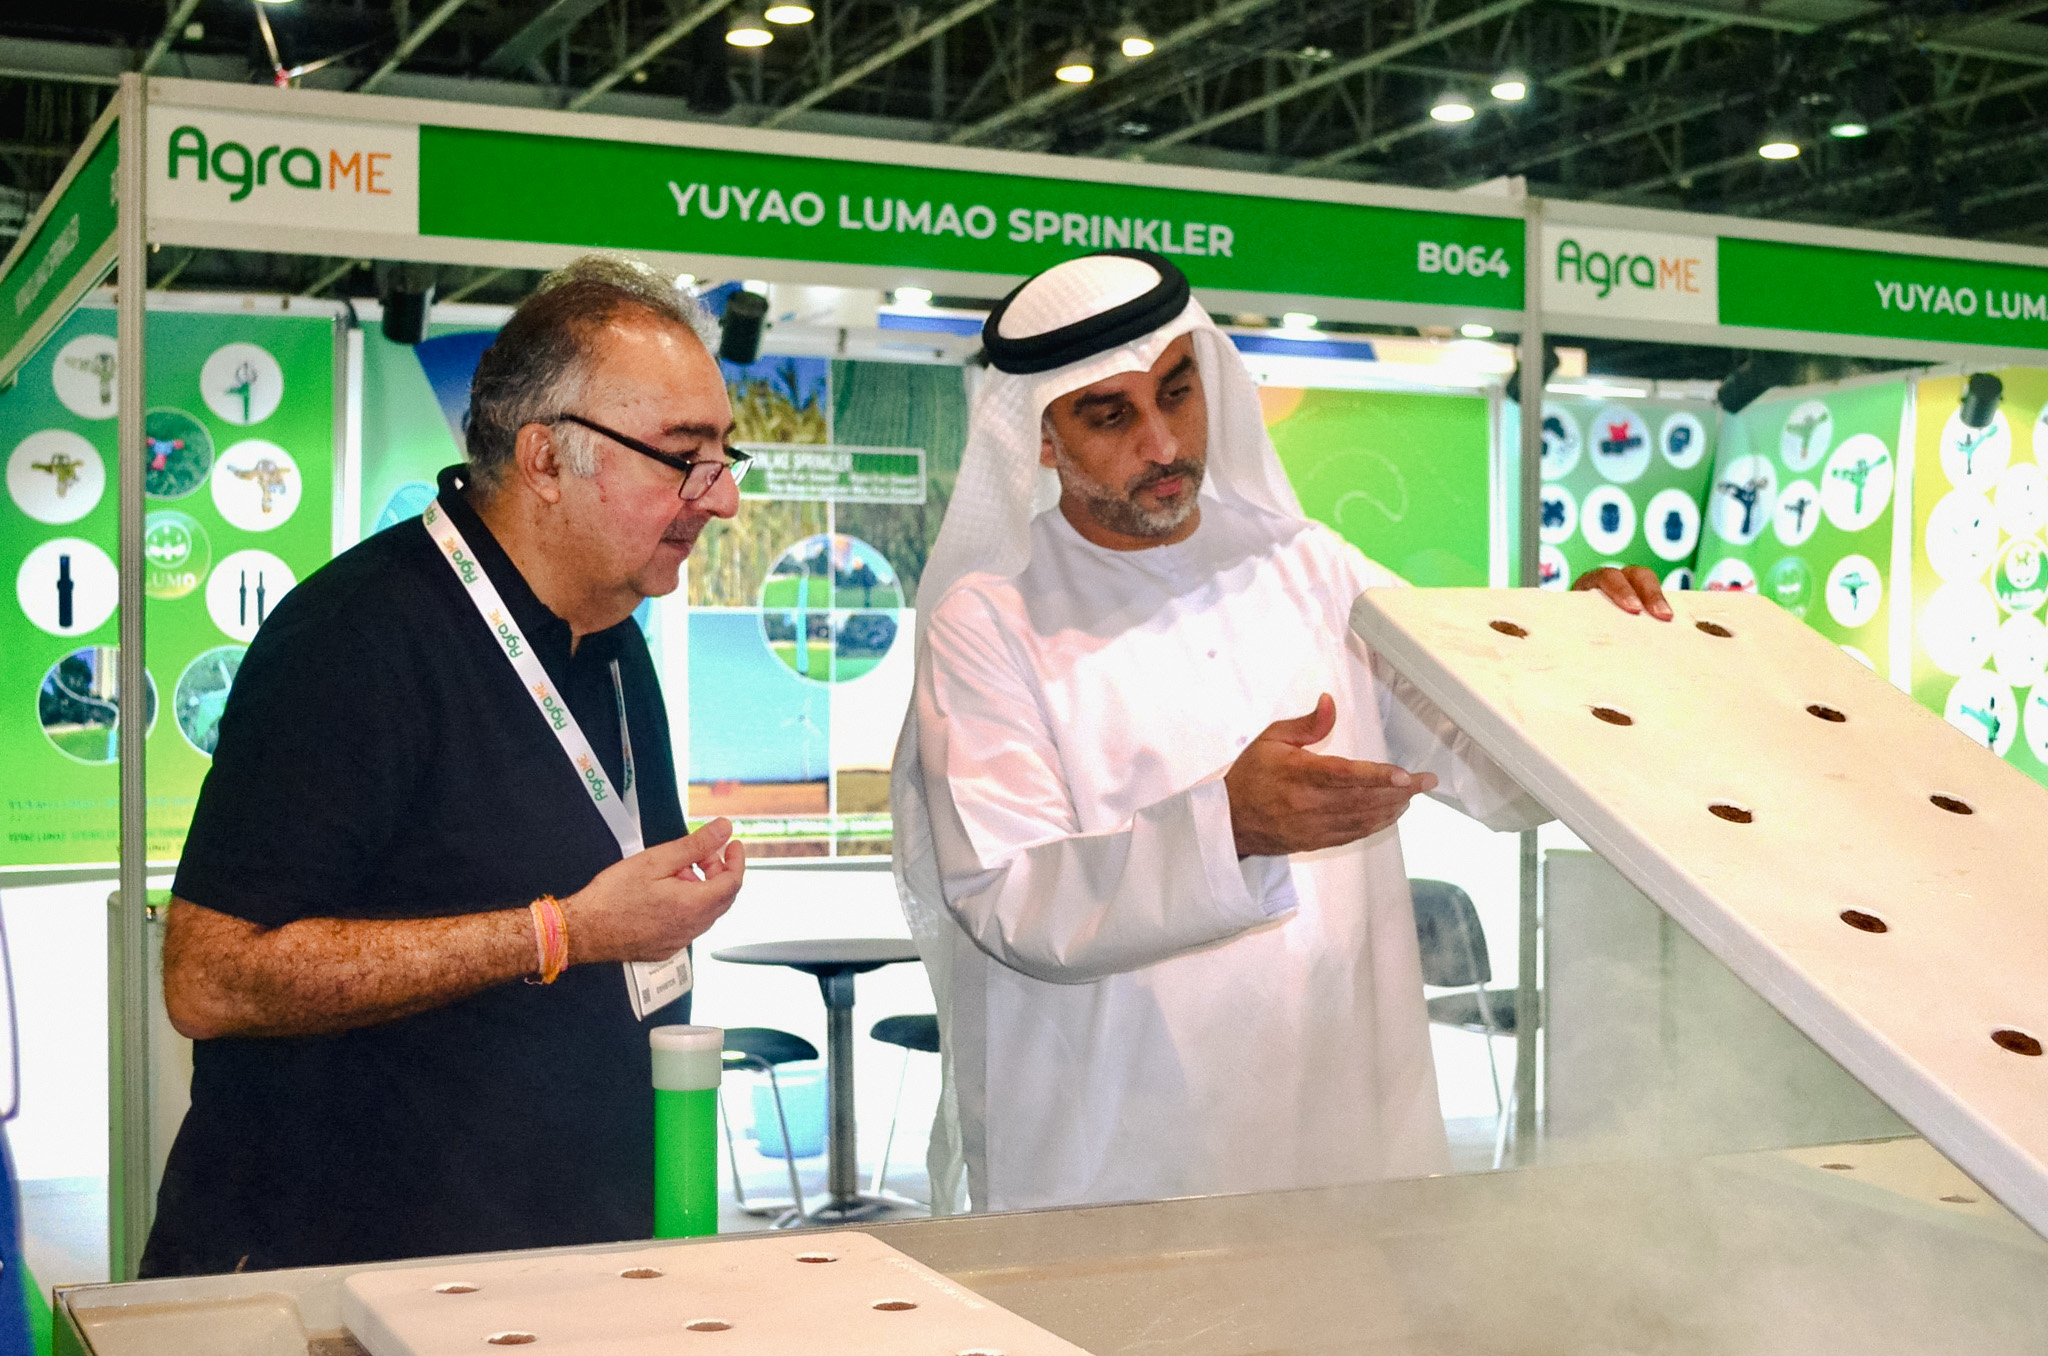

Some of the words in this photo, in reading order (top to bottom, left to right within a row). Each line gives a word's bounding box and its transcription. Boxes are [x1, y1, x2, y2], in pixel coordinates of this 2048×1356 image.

[168, 125, 392, 202] AgraME
[668, 181, 825, 227] YUYAO
[839, 194, 997, 239] LUMAO
[1007, 208, 1235, 258] SPRINKLER
[1417, 241, 1510, 279] B064
[1557, 239, 1700, 299] AgraME
[1874, 280, 1978, 316] YUYAO
[1985, 289, 2048, 322] LUM
